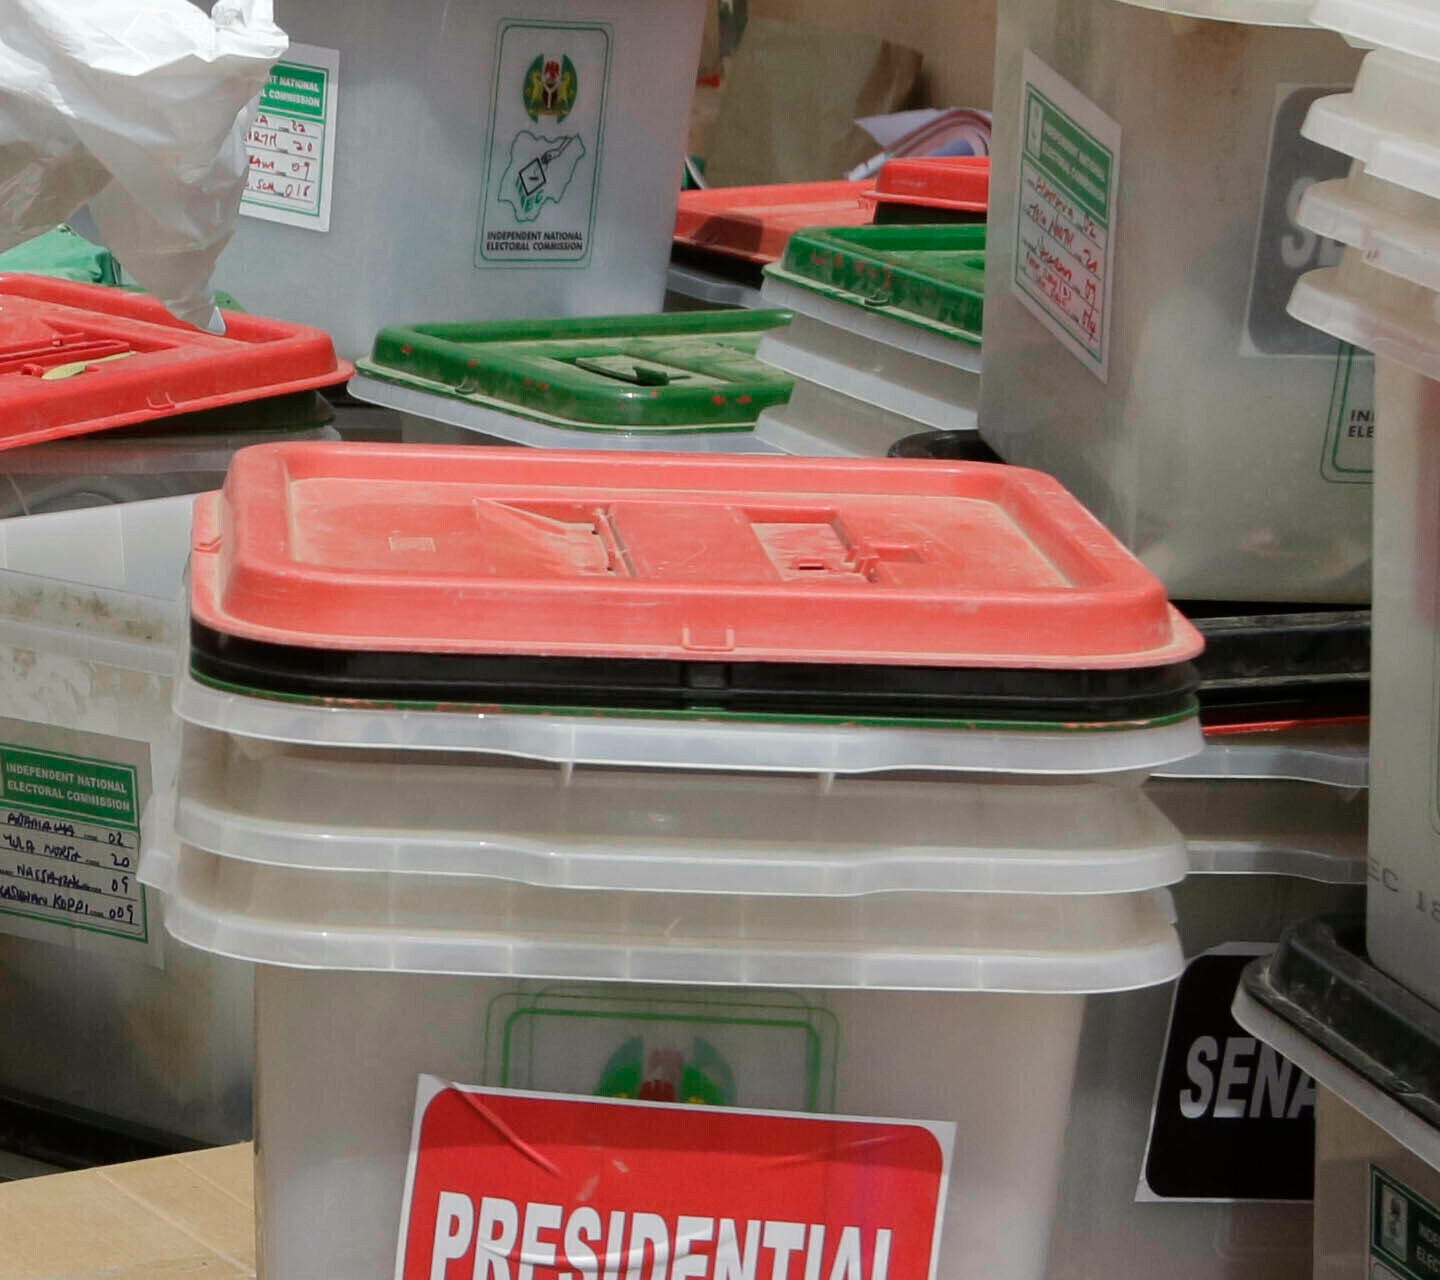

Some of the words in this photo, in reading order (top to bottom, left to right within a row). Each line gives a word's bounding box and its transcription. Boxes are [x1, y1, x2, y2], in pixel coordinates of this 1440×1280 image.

[487, 231, 541, 240] INDEPENDENT
[543, 231, 583, 241] NATIONAL
[486, 241, 529, 251] ELECTORAL
[533, 241, 583, 251] COMMISSION
[6, 761, 74, 785] INDEPENDENT
[77, 775, 127, 794] NATIONAL
[7, 780, 64, 800] ELECTORAL
[66, 790, 130, 812] COMMISSION
[111, 853, 130, 868] 20
